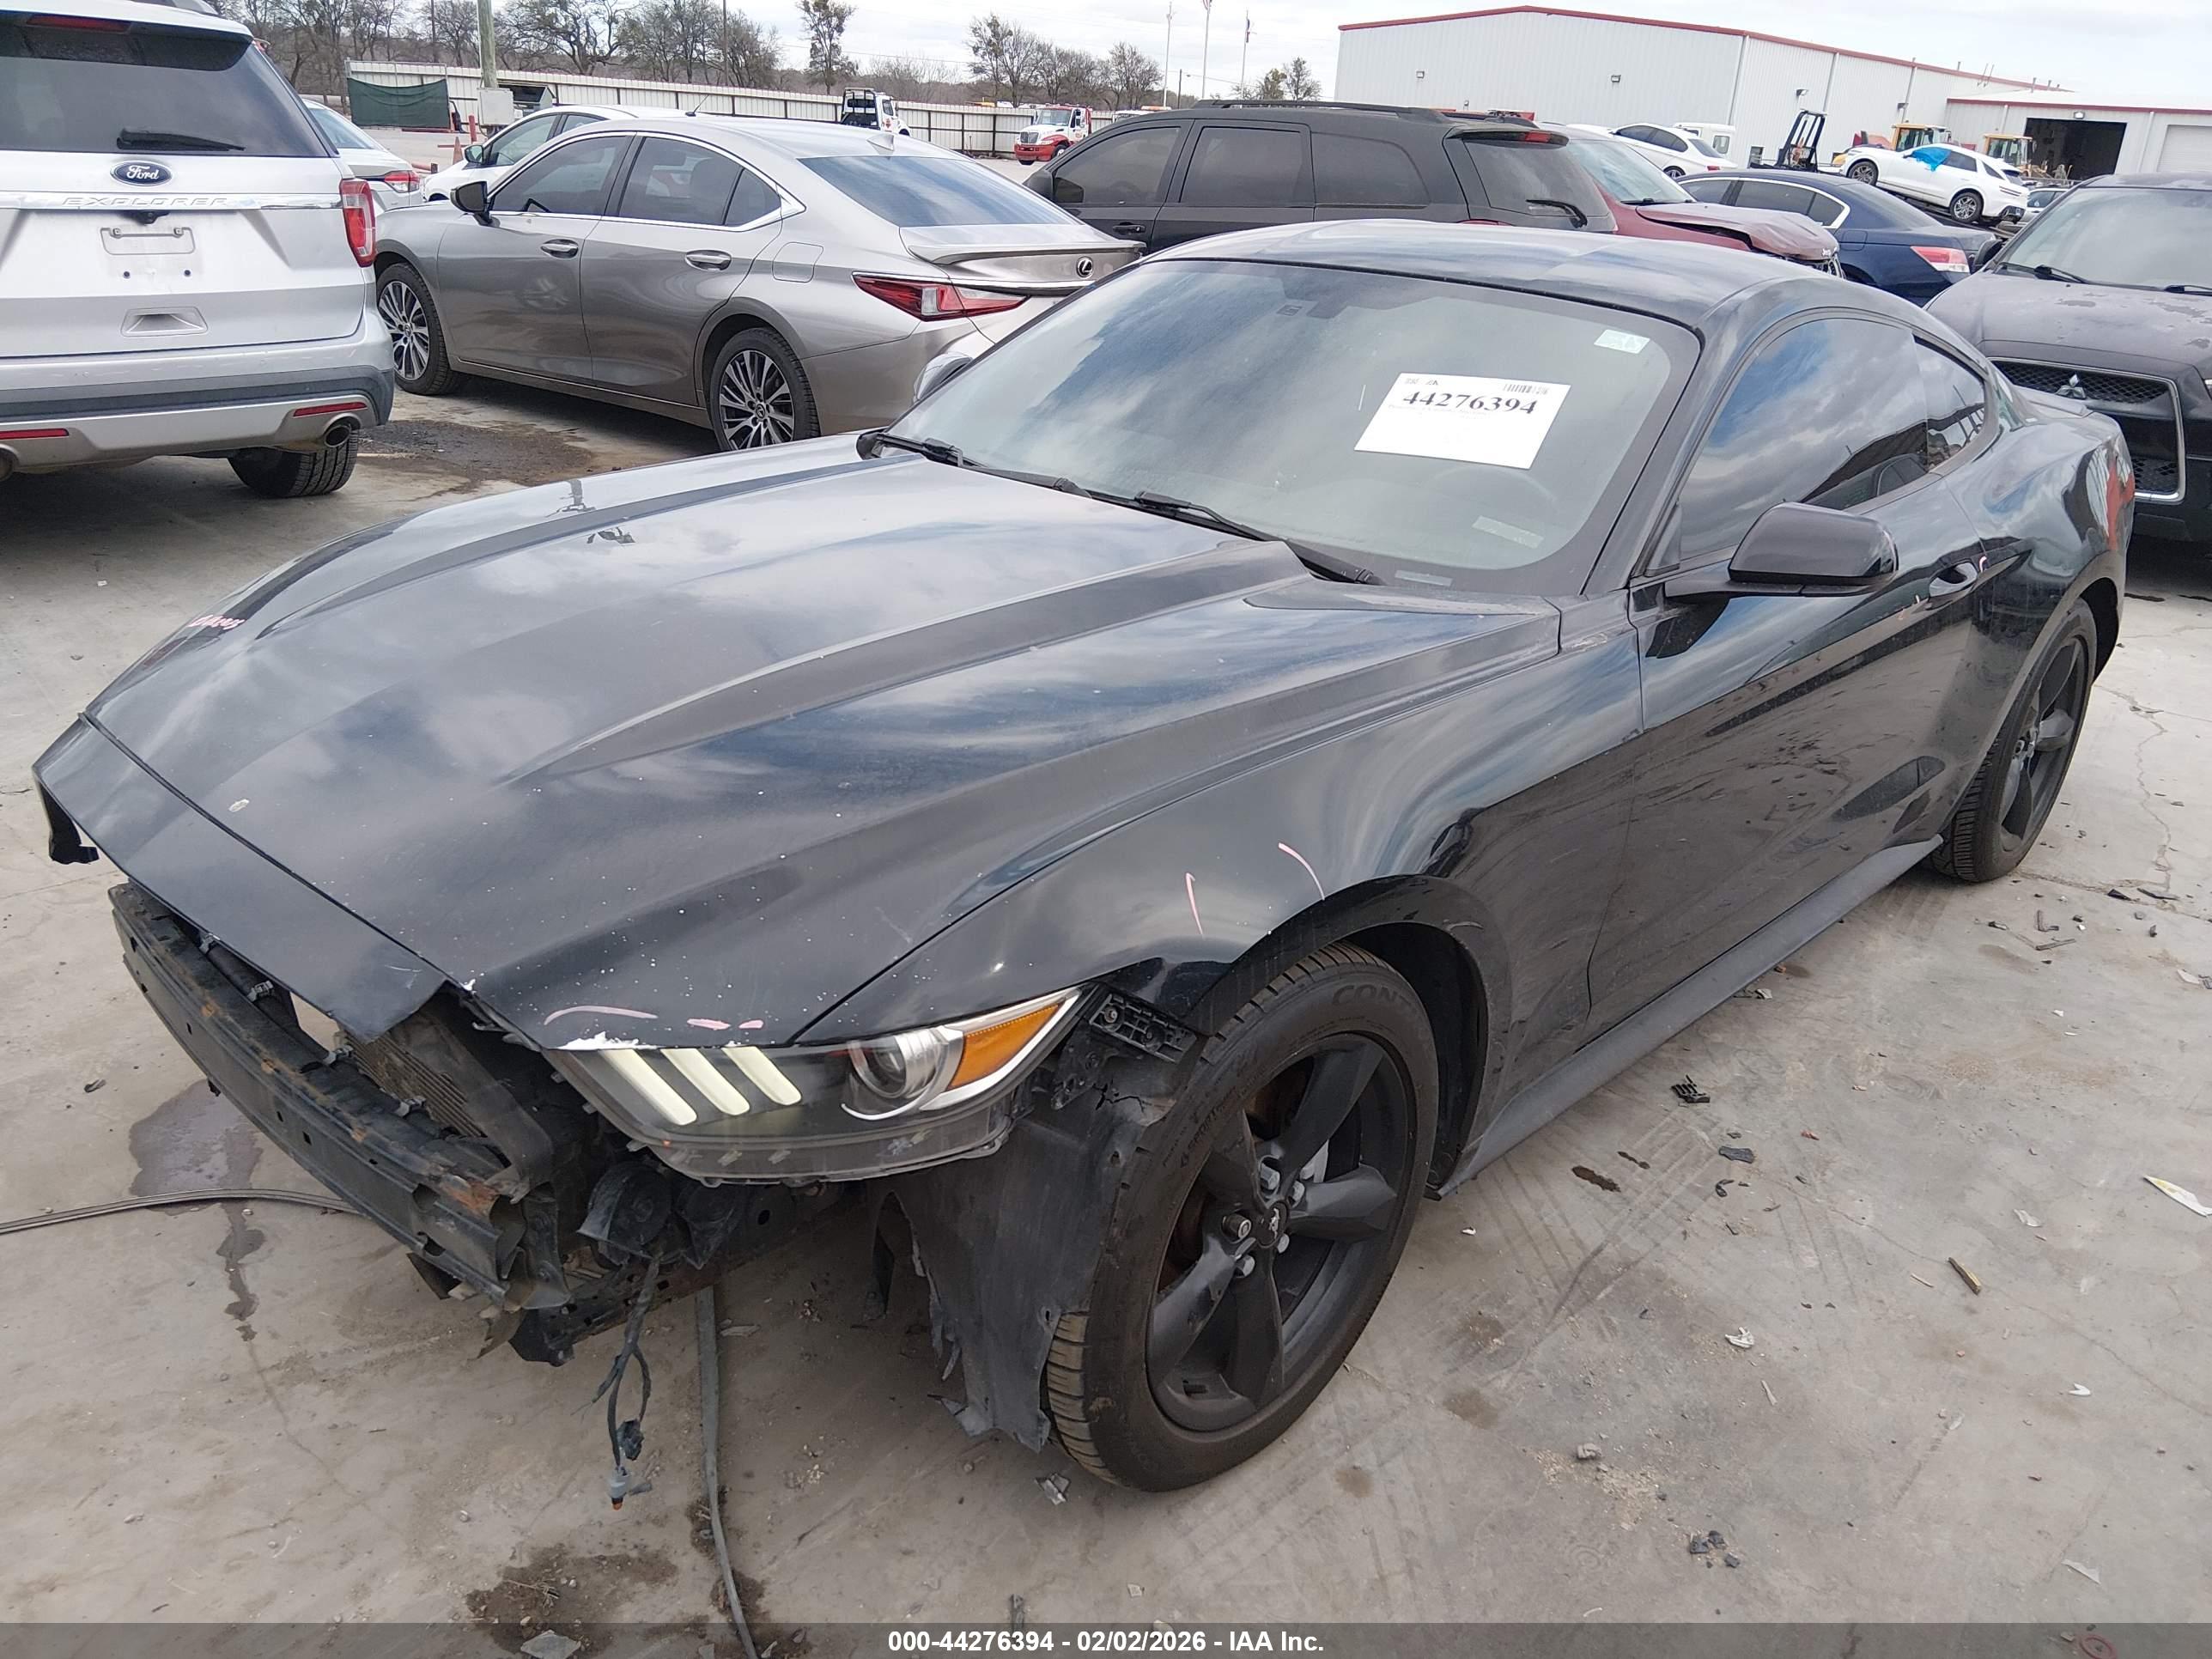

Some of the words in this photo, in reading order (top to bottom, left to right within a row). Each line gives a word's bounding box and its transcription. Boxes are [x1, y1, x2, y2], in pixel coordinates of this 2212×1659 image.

[126, 165, 160, 179] Ford
[62, 197, 228, 206] EXPLORER
[1402, 391, 1539, 415] 44276394
